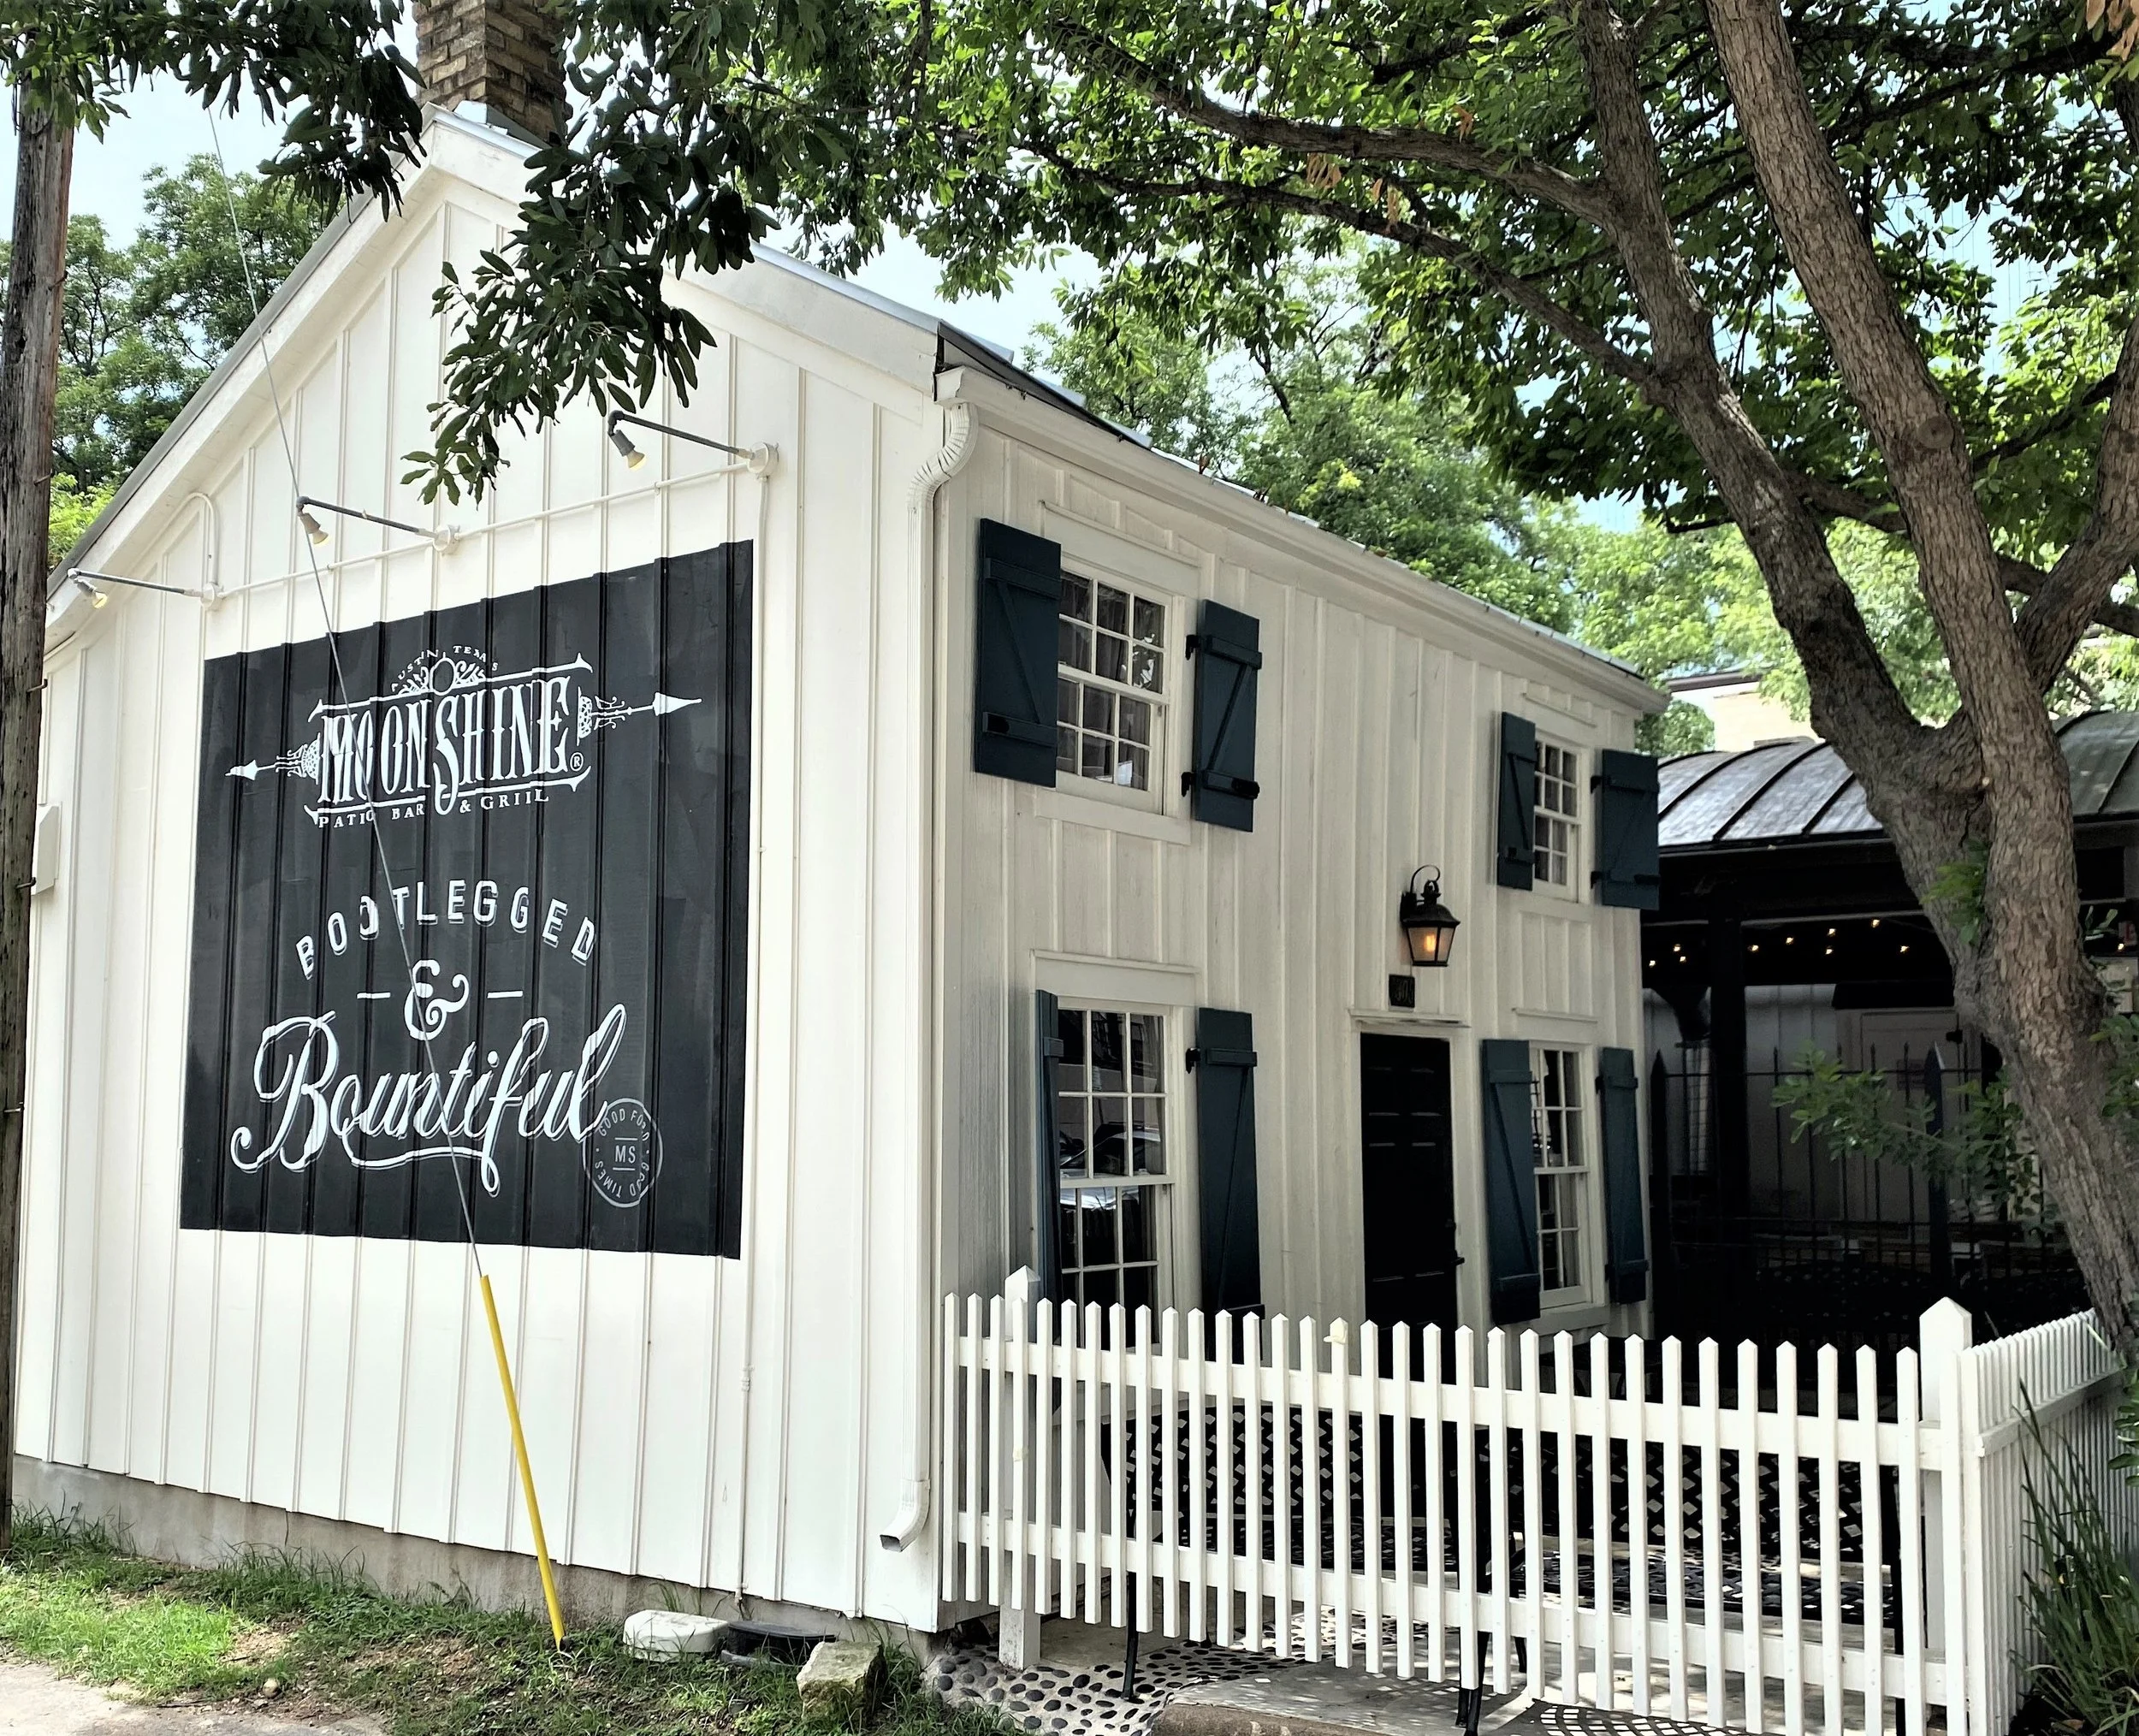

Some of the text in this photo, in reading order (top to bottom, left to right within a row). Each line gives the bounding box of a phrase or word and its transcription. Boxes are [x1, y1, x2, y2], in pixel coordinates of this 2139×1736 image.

[453, 645, 498, 671] TEXAS
[317, 676, 570, 815] MOONSHINE
[318, 809, 376, 828] PATIO
[391, 803, 425, 821] BAR
[459, 799, 471, 813] &
[296, 880, 596, 980] BOOTLEGGED
[404, 958, 470, 1040] &
[230, 1004, 627, 1197] Bountiful
[599, 1108, 625, 1136] GOOD
[614, 1145, 637, 1164] MS
[595, 1160, 622, 1199] TIMES
